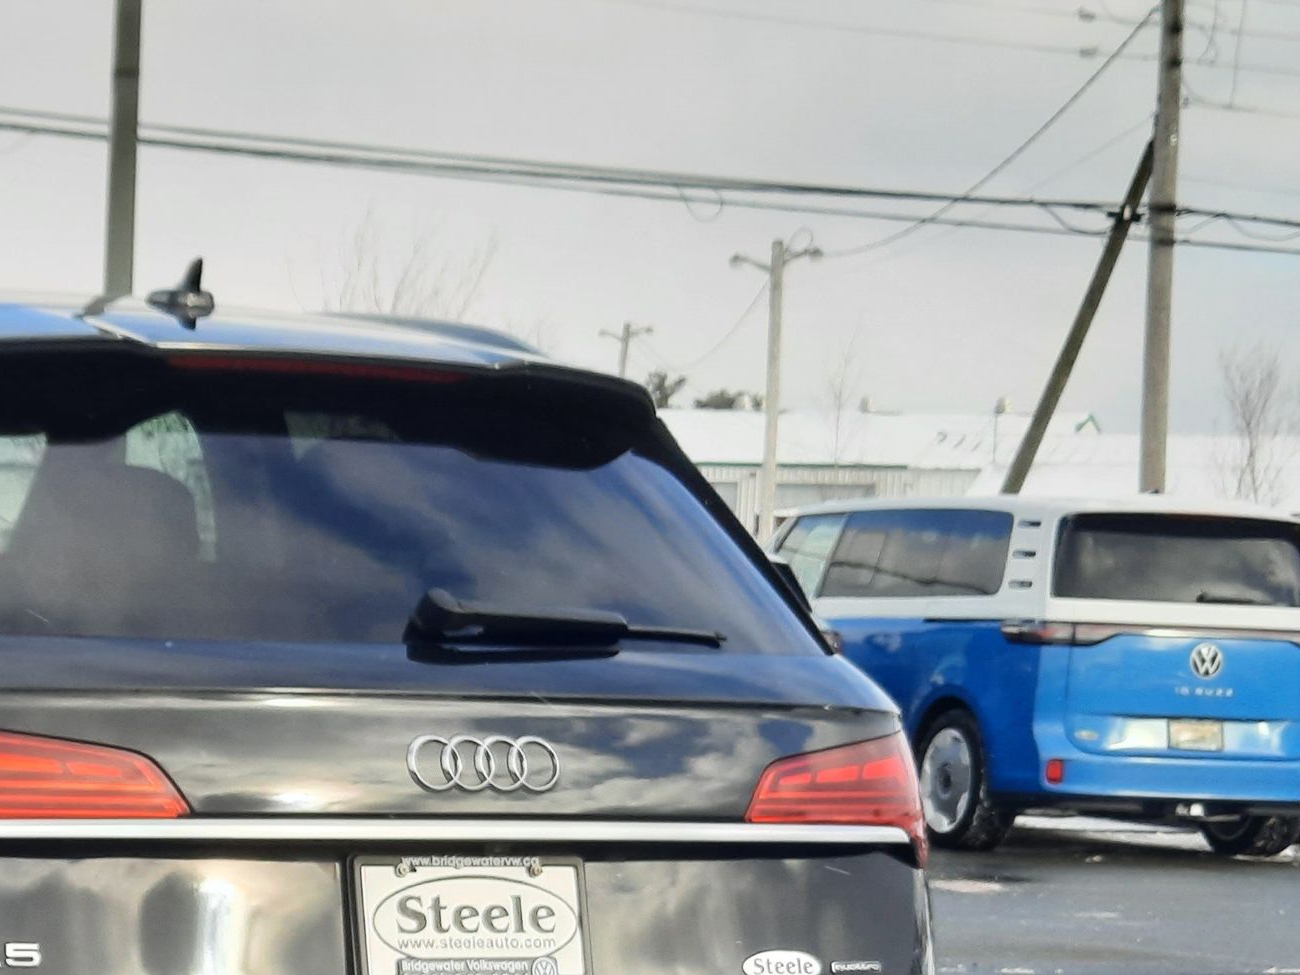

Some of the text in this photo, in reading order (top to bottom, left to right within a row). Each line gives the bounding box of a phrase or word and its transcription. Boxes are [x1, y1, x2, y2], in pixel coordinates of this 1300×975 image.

[401, 856, 540, 869] www.bridgewatervw.ca
[396, 894, 556, 934] Steele
[397, 937, 556, 950] www.steeleauto.com
[402, 959, 528, 973] Bridgewater Volkswagen
[753, 957, 814, 975] Steele
